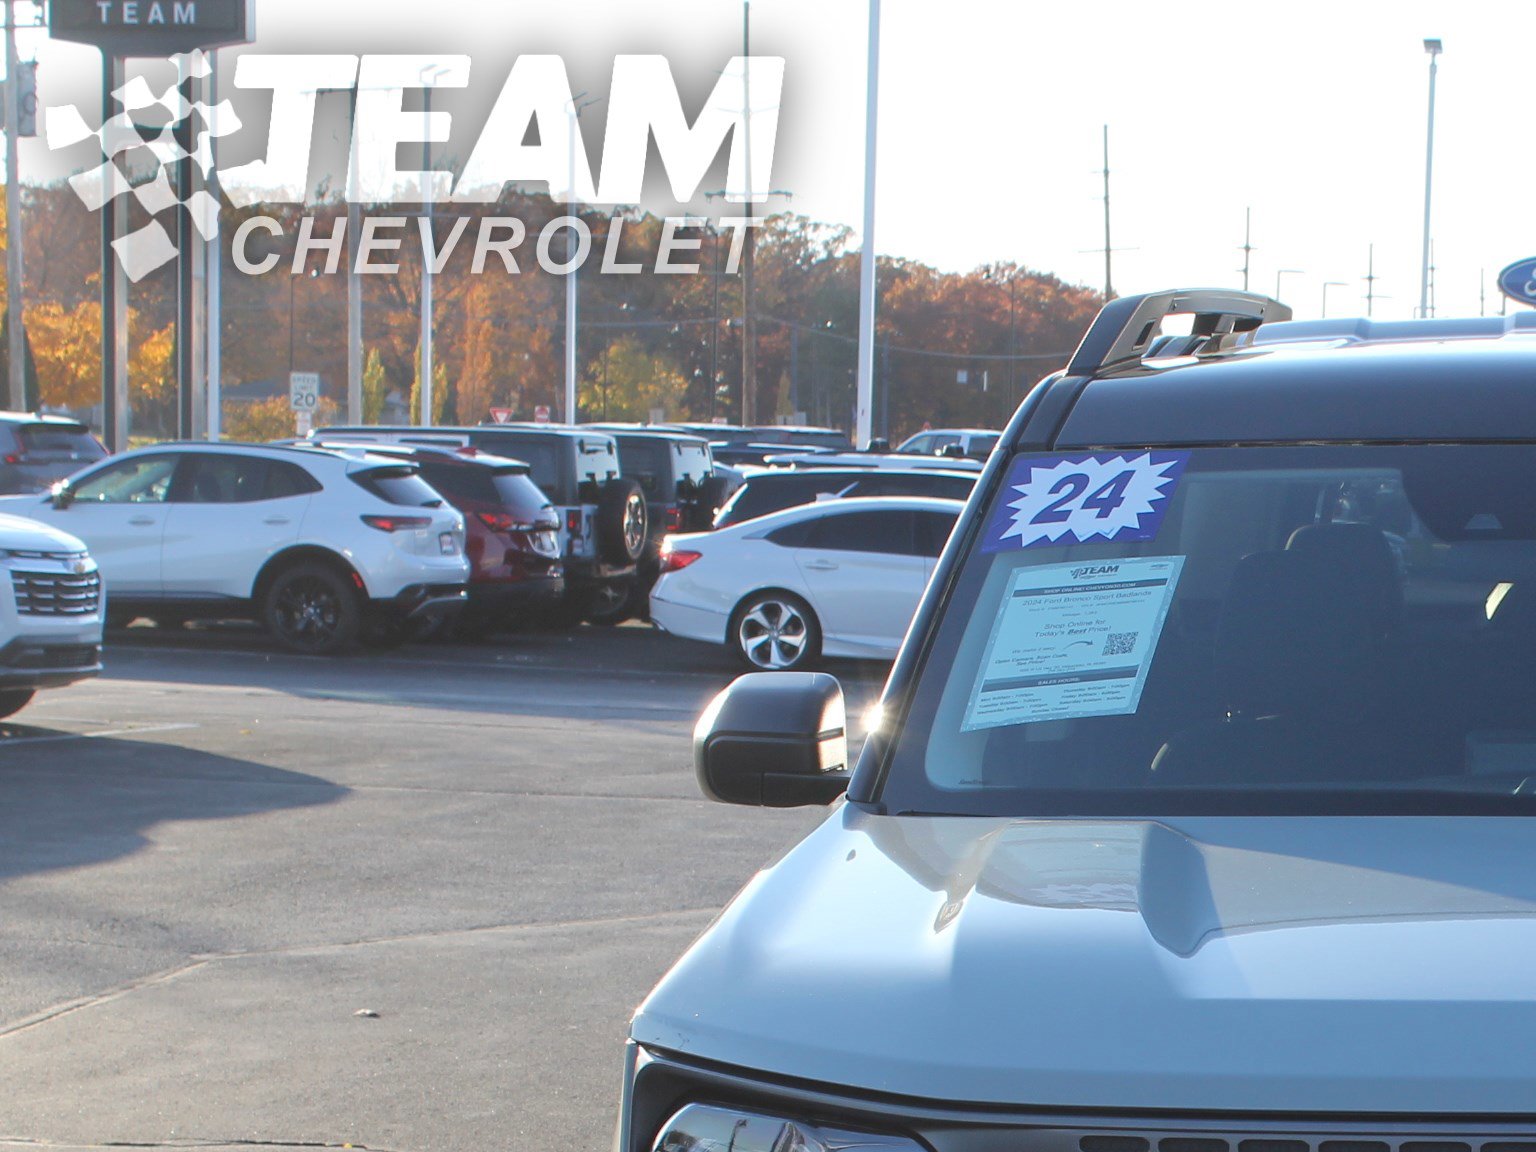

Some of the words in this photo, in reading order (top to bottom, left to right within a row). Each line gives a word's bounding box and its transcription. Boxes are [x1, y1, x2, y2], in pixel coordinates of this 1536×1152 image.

[96, 1, 196, 24] TEAM
[294, 393, 316, 408] 20
[1029, 470, 1136, 525] 24
[1083, 565, 1120, 575] TEAM
[1044, 597, 1062, 605] Ford
